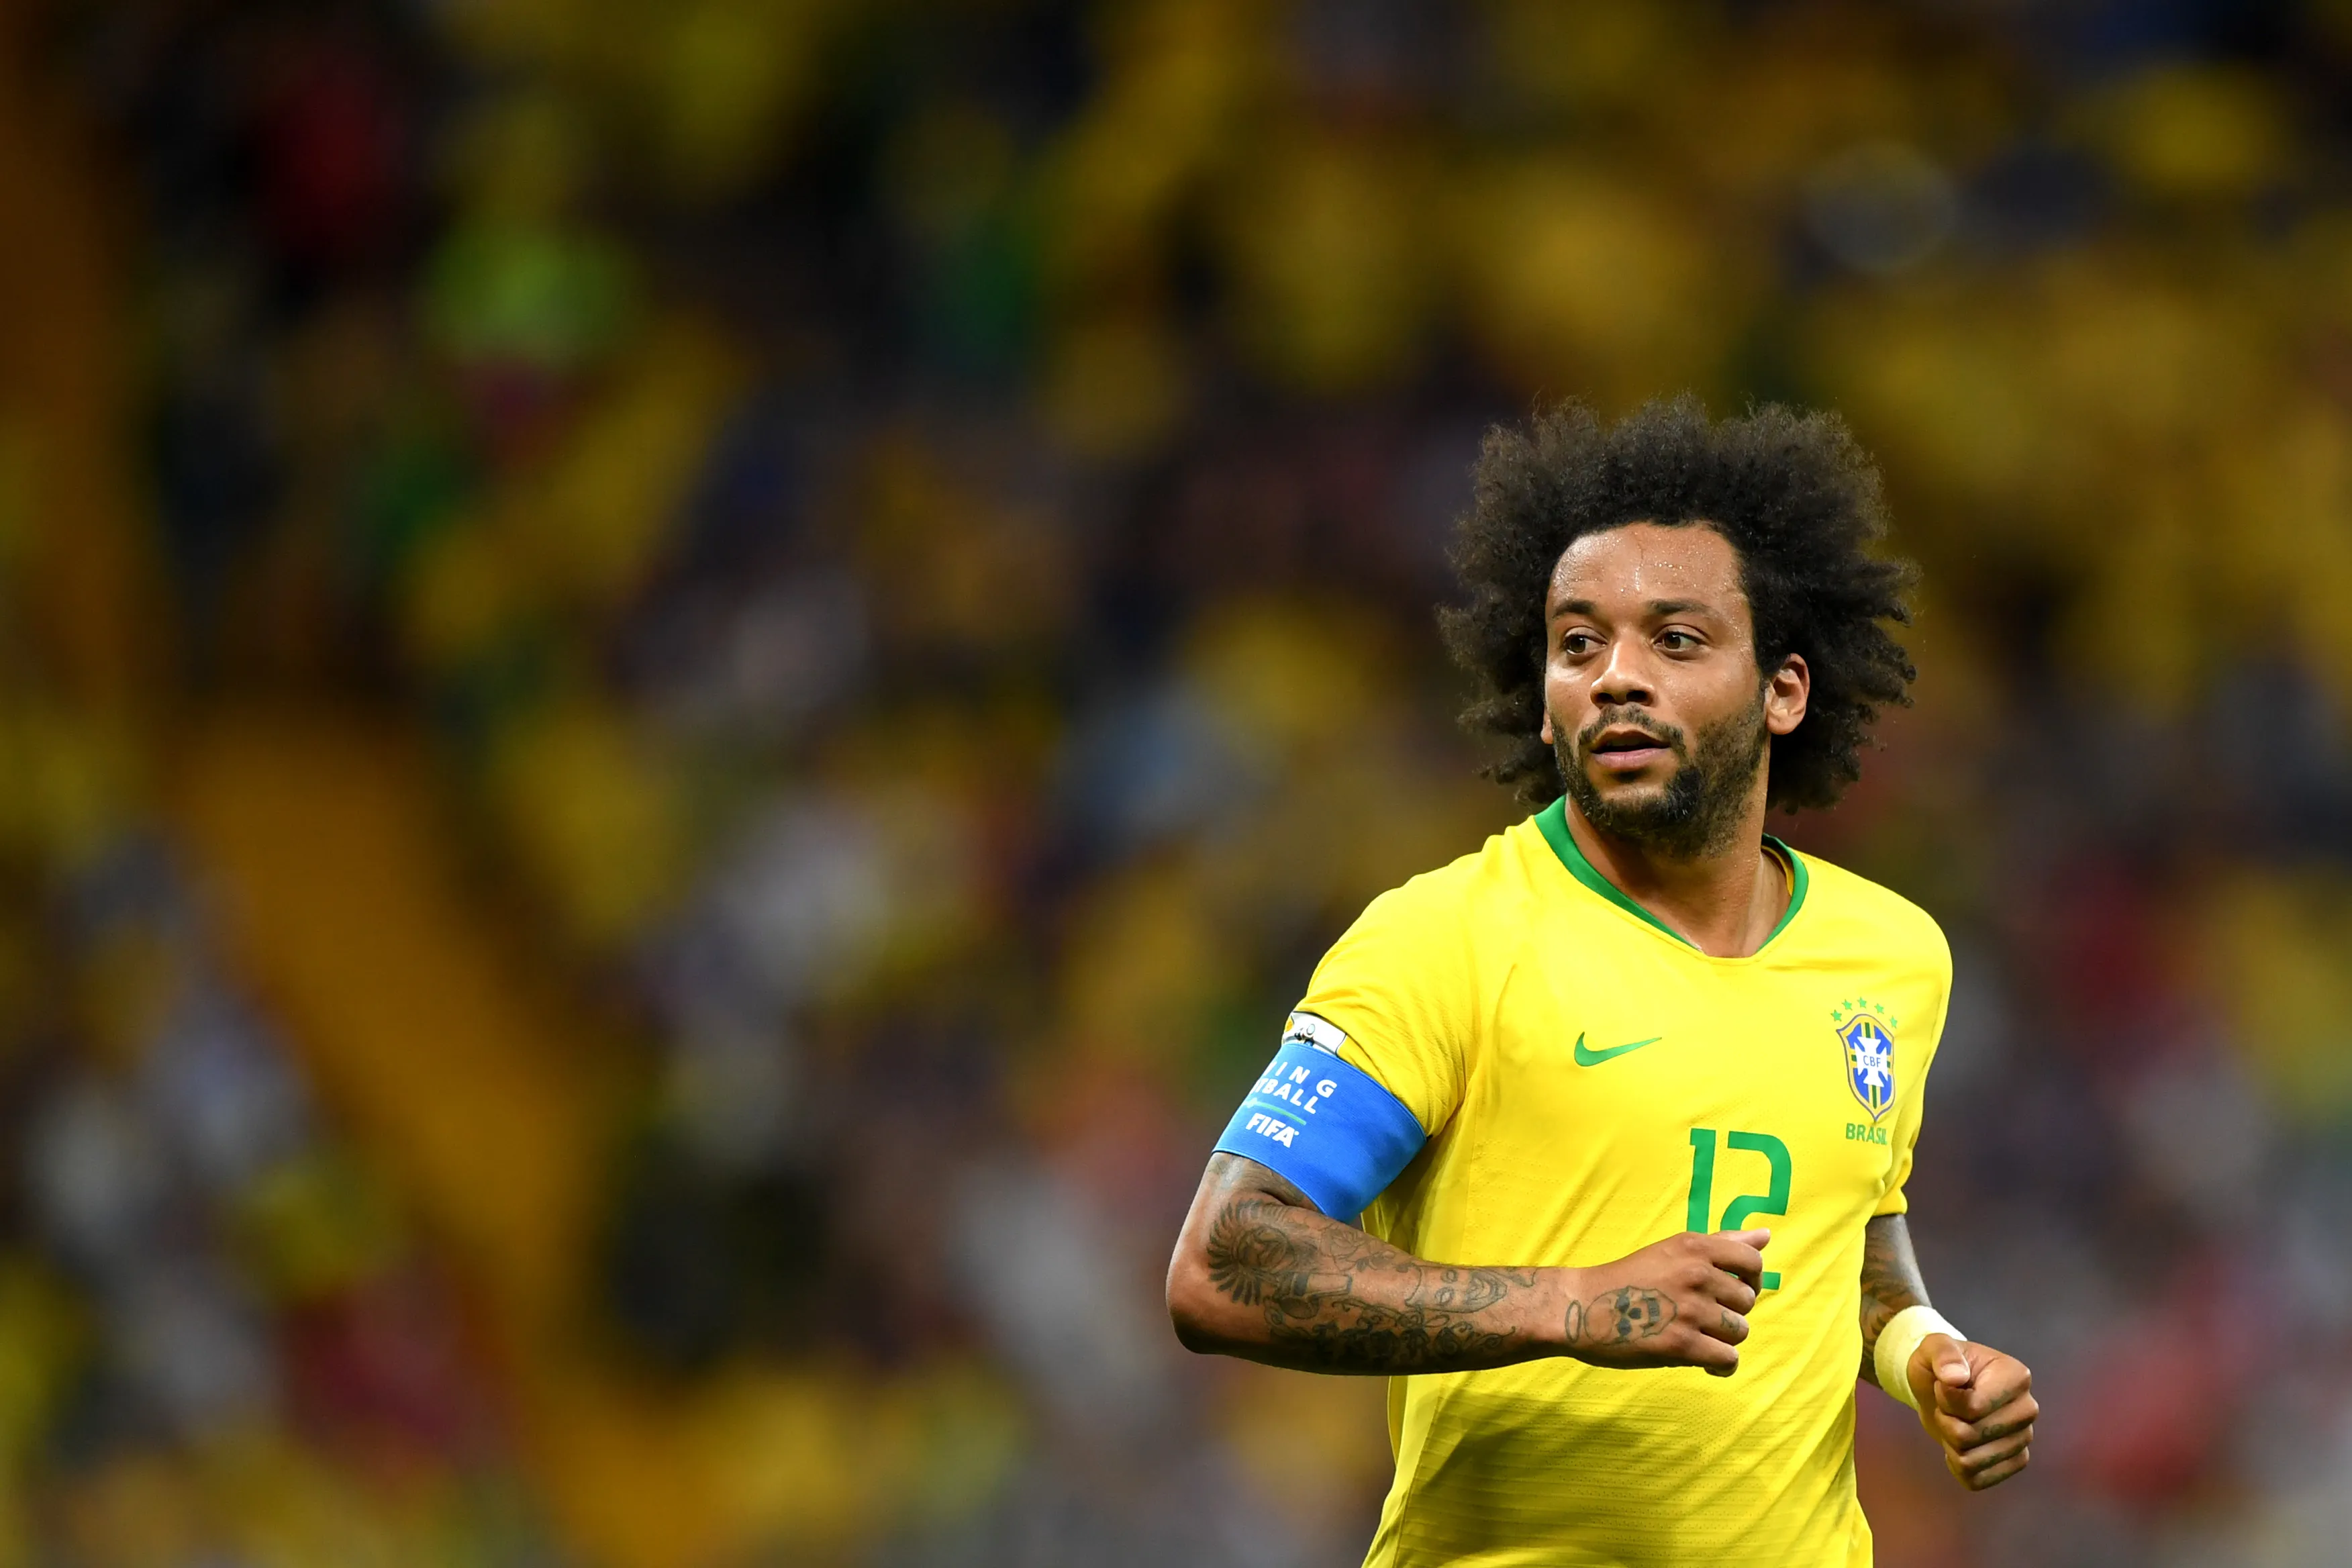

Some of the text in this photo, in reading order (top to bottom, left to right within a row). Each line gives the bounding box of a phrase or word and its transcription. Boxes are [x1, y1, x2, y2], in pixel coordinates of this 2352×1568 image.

[1863, 1055, 1881, 1067] CBF
[1249, 1078, 1318, 1114] TBALL
[1246, 1112, 1300, 1148] FIFA
[1846, 1123, 1888, 1145] BRASIL
[1687, 1128, 1792, 1290] 12
